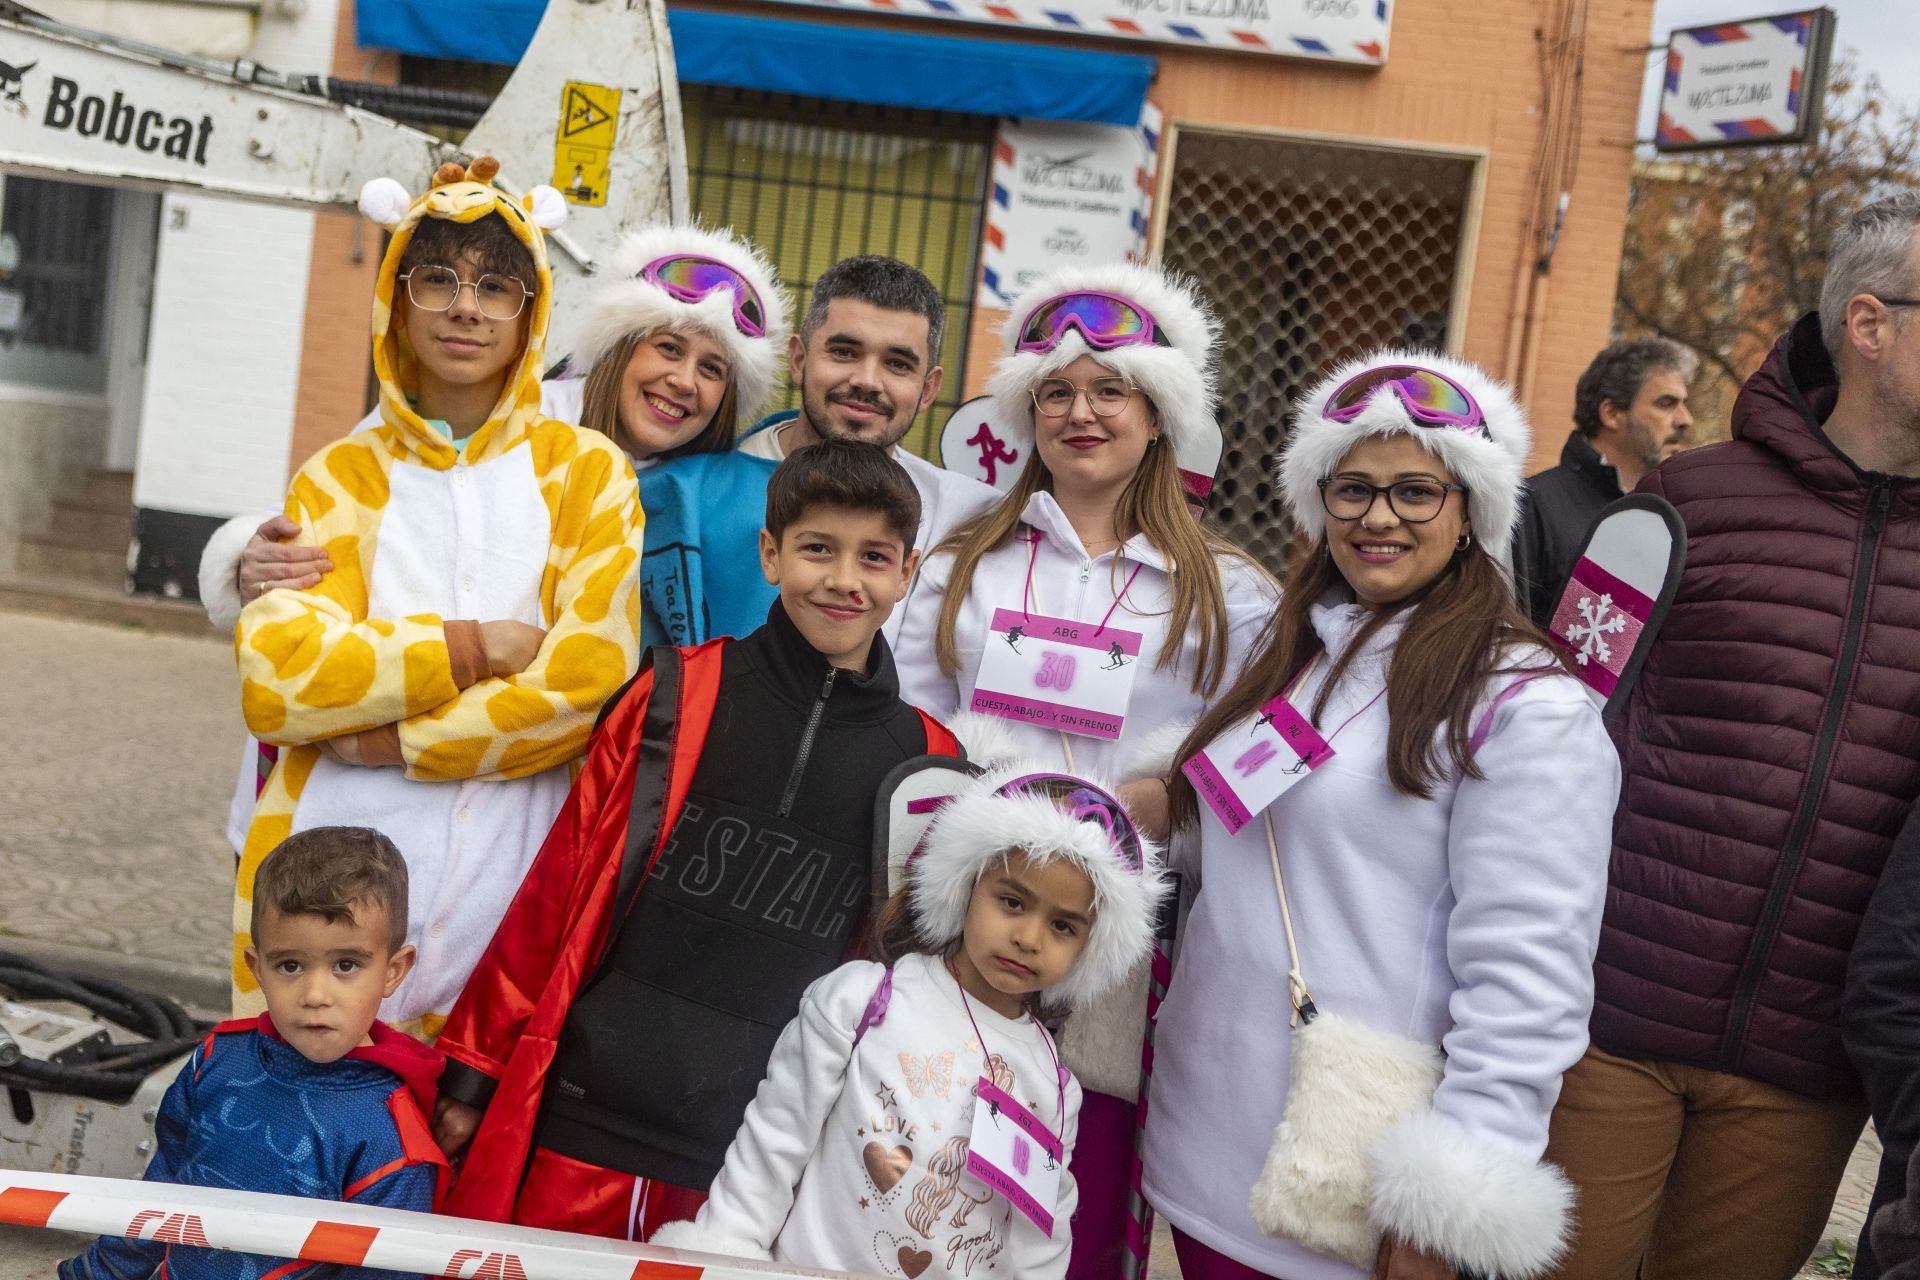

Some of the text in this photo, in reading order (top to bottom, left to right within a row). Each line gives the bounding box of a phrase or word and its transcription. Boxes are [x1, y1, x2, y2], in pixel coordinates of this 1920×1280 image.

[43, 75, 214, 167] Bobcat
[1052, 626, 1079, 639] ABG
[1035, 651, 1076, 692] 30
[975, 698, 1011, 712] CUESTA
[1051, 712, 1059, 721] Y
[1060, 714, 1077, 725] SIN
[1079, 718, 1118, 733] FRENOS
[871, 1114, 920, 1142] LOVE
[1018, 1112, 1032, 1130] ZGZ
